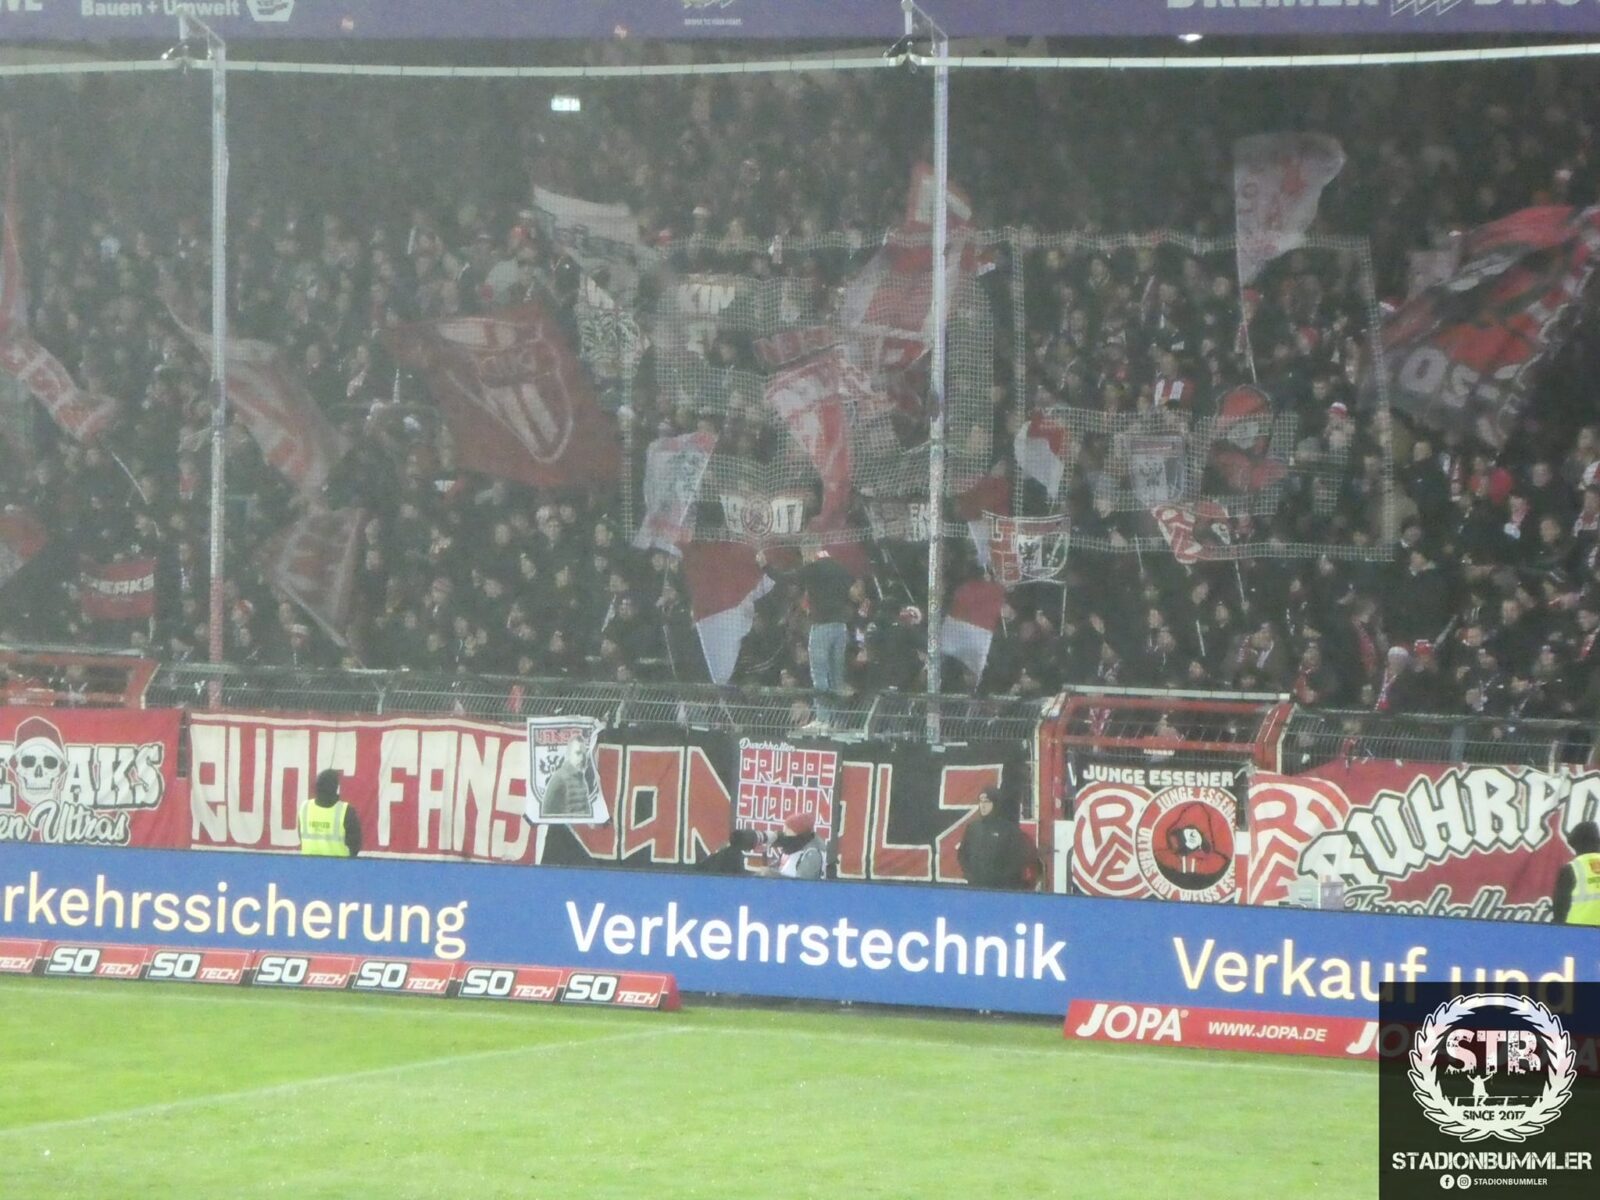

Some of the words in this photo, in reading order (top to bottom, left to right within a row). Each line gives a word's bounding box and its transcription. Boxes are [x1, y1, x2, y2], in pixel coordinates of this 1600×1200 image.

[81, 0, 142, 16] Bauen
[739, 750, 837, 788] GRUPPE
[1083, 764, 1146, 786] JUNGE
[1149, 769, 1234, 787] ESSENER
[378, 729, 531, 861] FANS
[736, 781, 833, 826] STADION
[566, 901, 1067, 981] Verkehrstechnik
[49, 948, 100, 973] SO
[99, 962, 139, 976] TECH
[150, 953, 200, 978] SO
[200, 967, 241, 981] TECH
[257, 957, 308, 983] SO
[307, 972, 348, 985] TECH
[357, 962, 408, 988] SO
[406, 977, 446, 991] TECH
[1173, 937, 1428, 1004] Verkauf
[463, 968, 515, 995] SO
[513, 984, 554, 998] TECH
[566, 974, 617, 1000] SO
[617, 990, 657, 1005] TECH
[1075, 1003, 1182, 1042] JOPA
[1208, 1020, 1328, 1042] WWW.JOPA.DE
